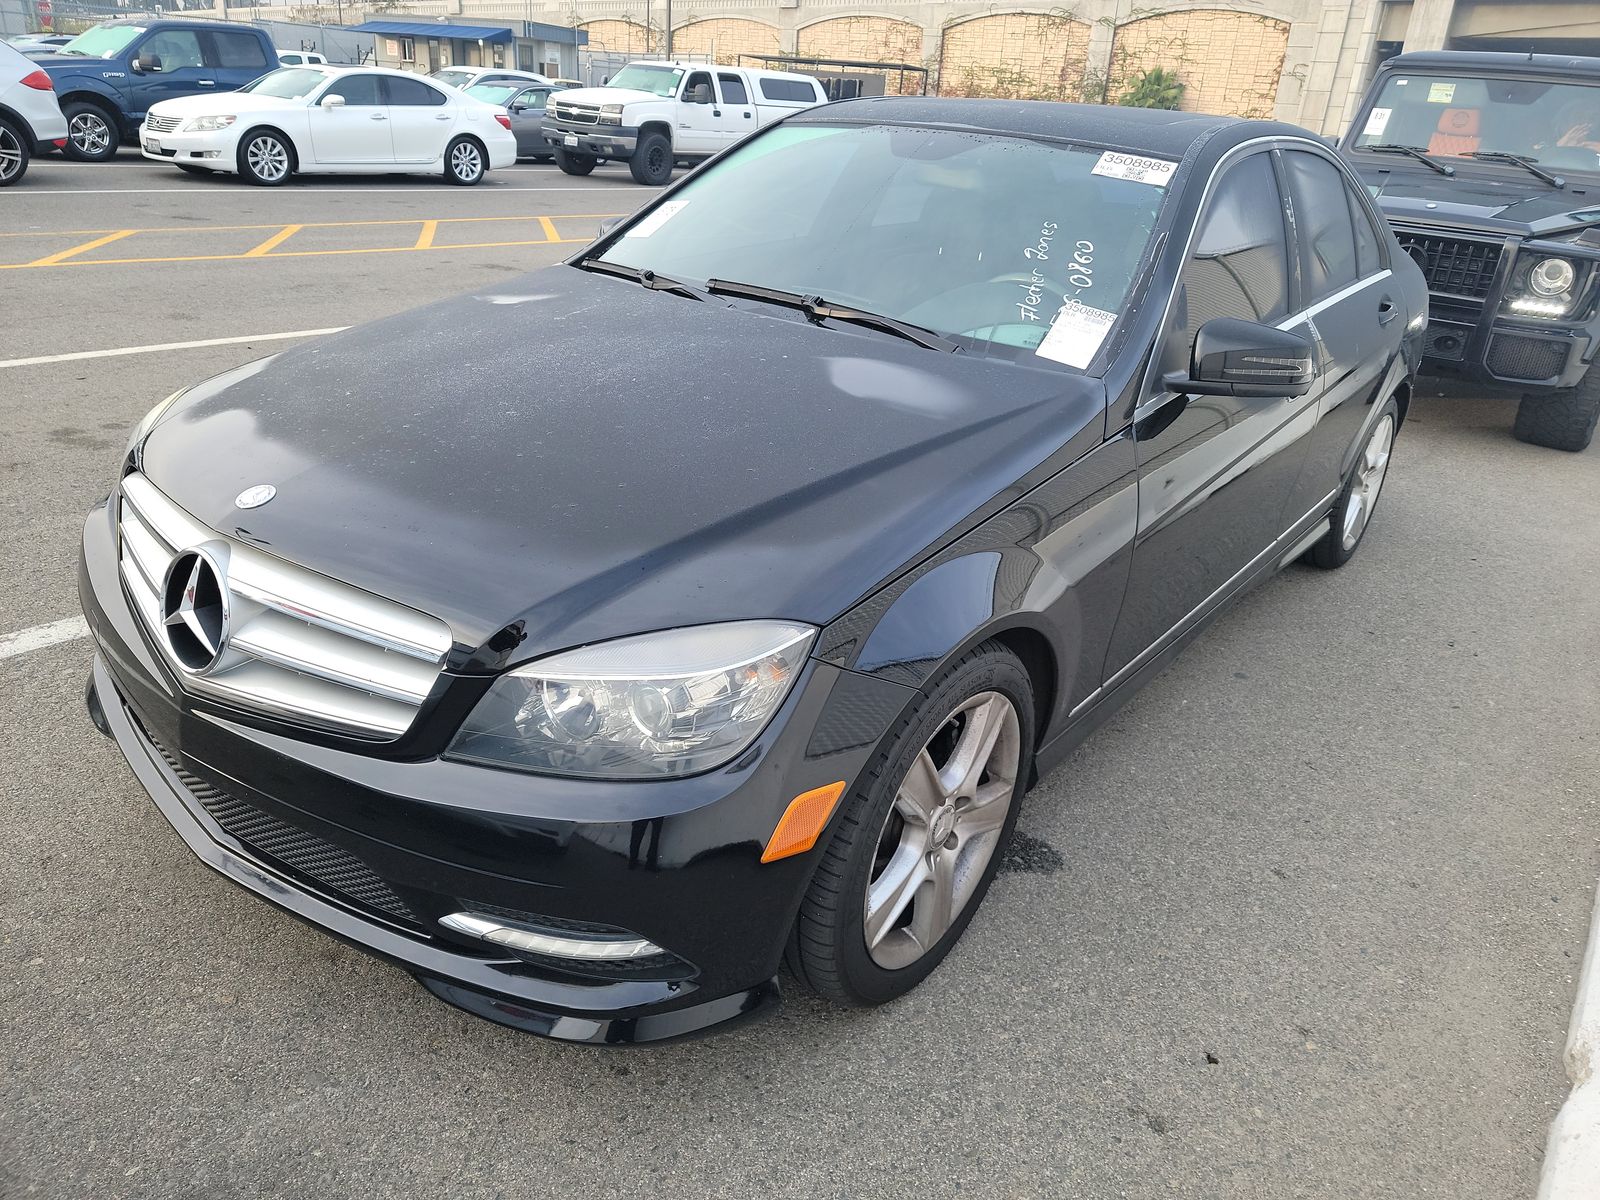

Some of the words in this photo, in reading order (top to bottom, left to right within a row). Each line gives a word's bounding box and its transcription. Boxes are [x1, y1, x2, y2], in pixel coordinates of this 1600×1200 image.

[1104, 153, 1171, 173] 3508985
[1023, 220, 1058, 261] Jones
[1064, 302, 1116, 323] 3508985
